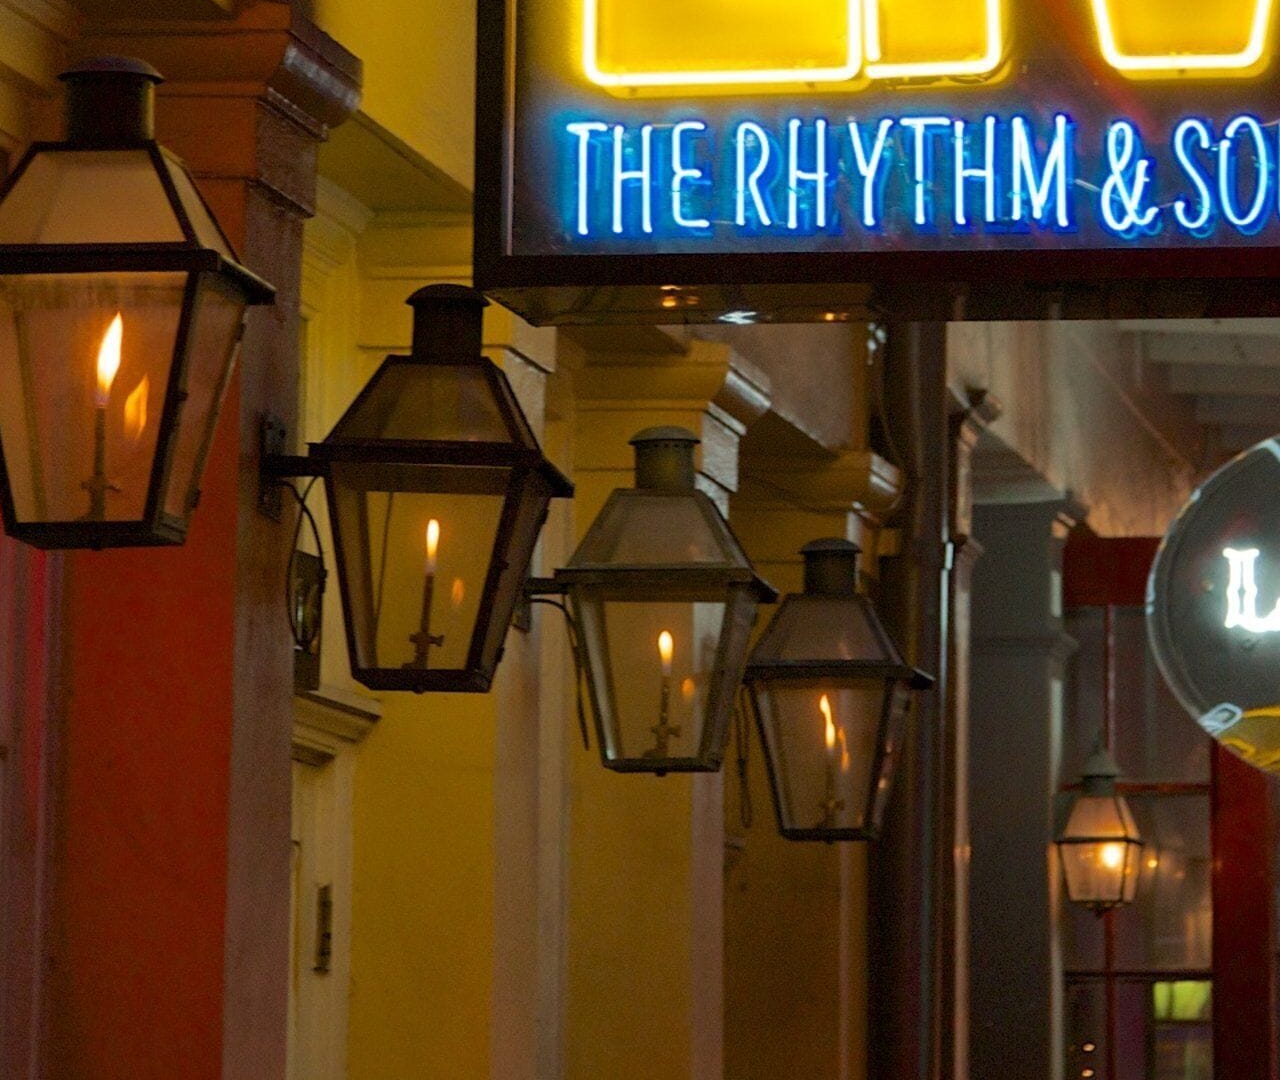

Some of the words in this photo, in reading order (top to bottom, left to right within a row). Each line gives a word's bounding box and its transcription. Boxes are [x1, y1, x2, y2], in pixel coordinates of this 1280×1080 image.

[566, 120, 711, 235] THE
[734, 114, 1070, 230] RHYTHM
[1100, 121, 1161, 231] &
